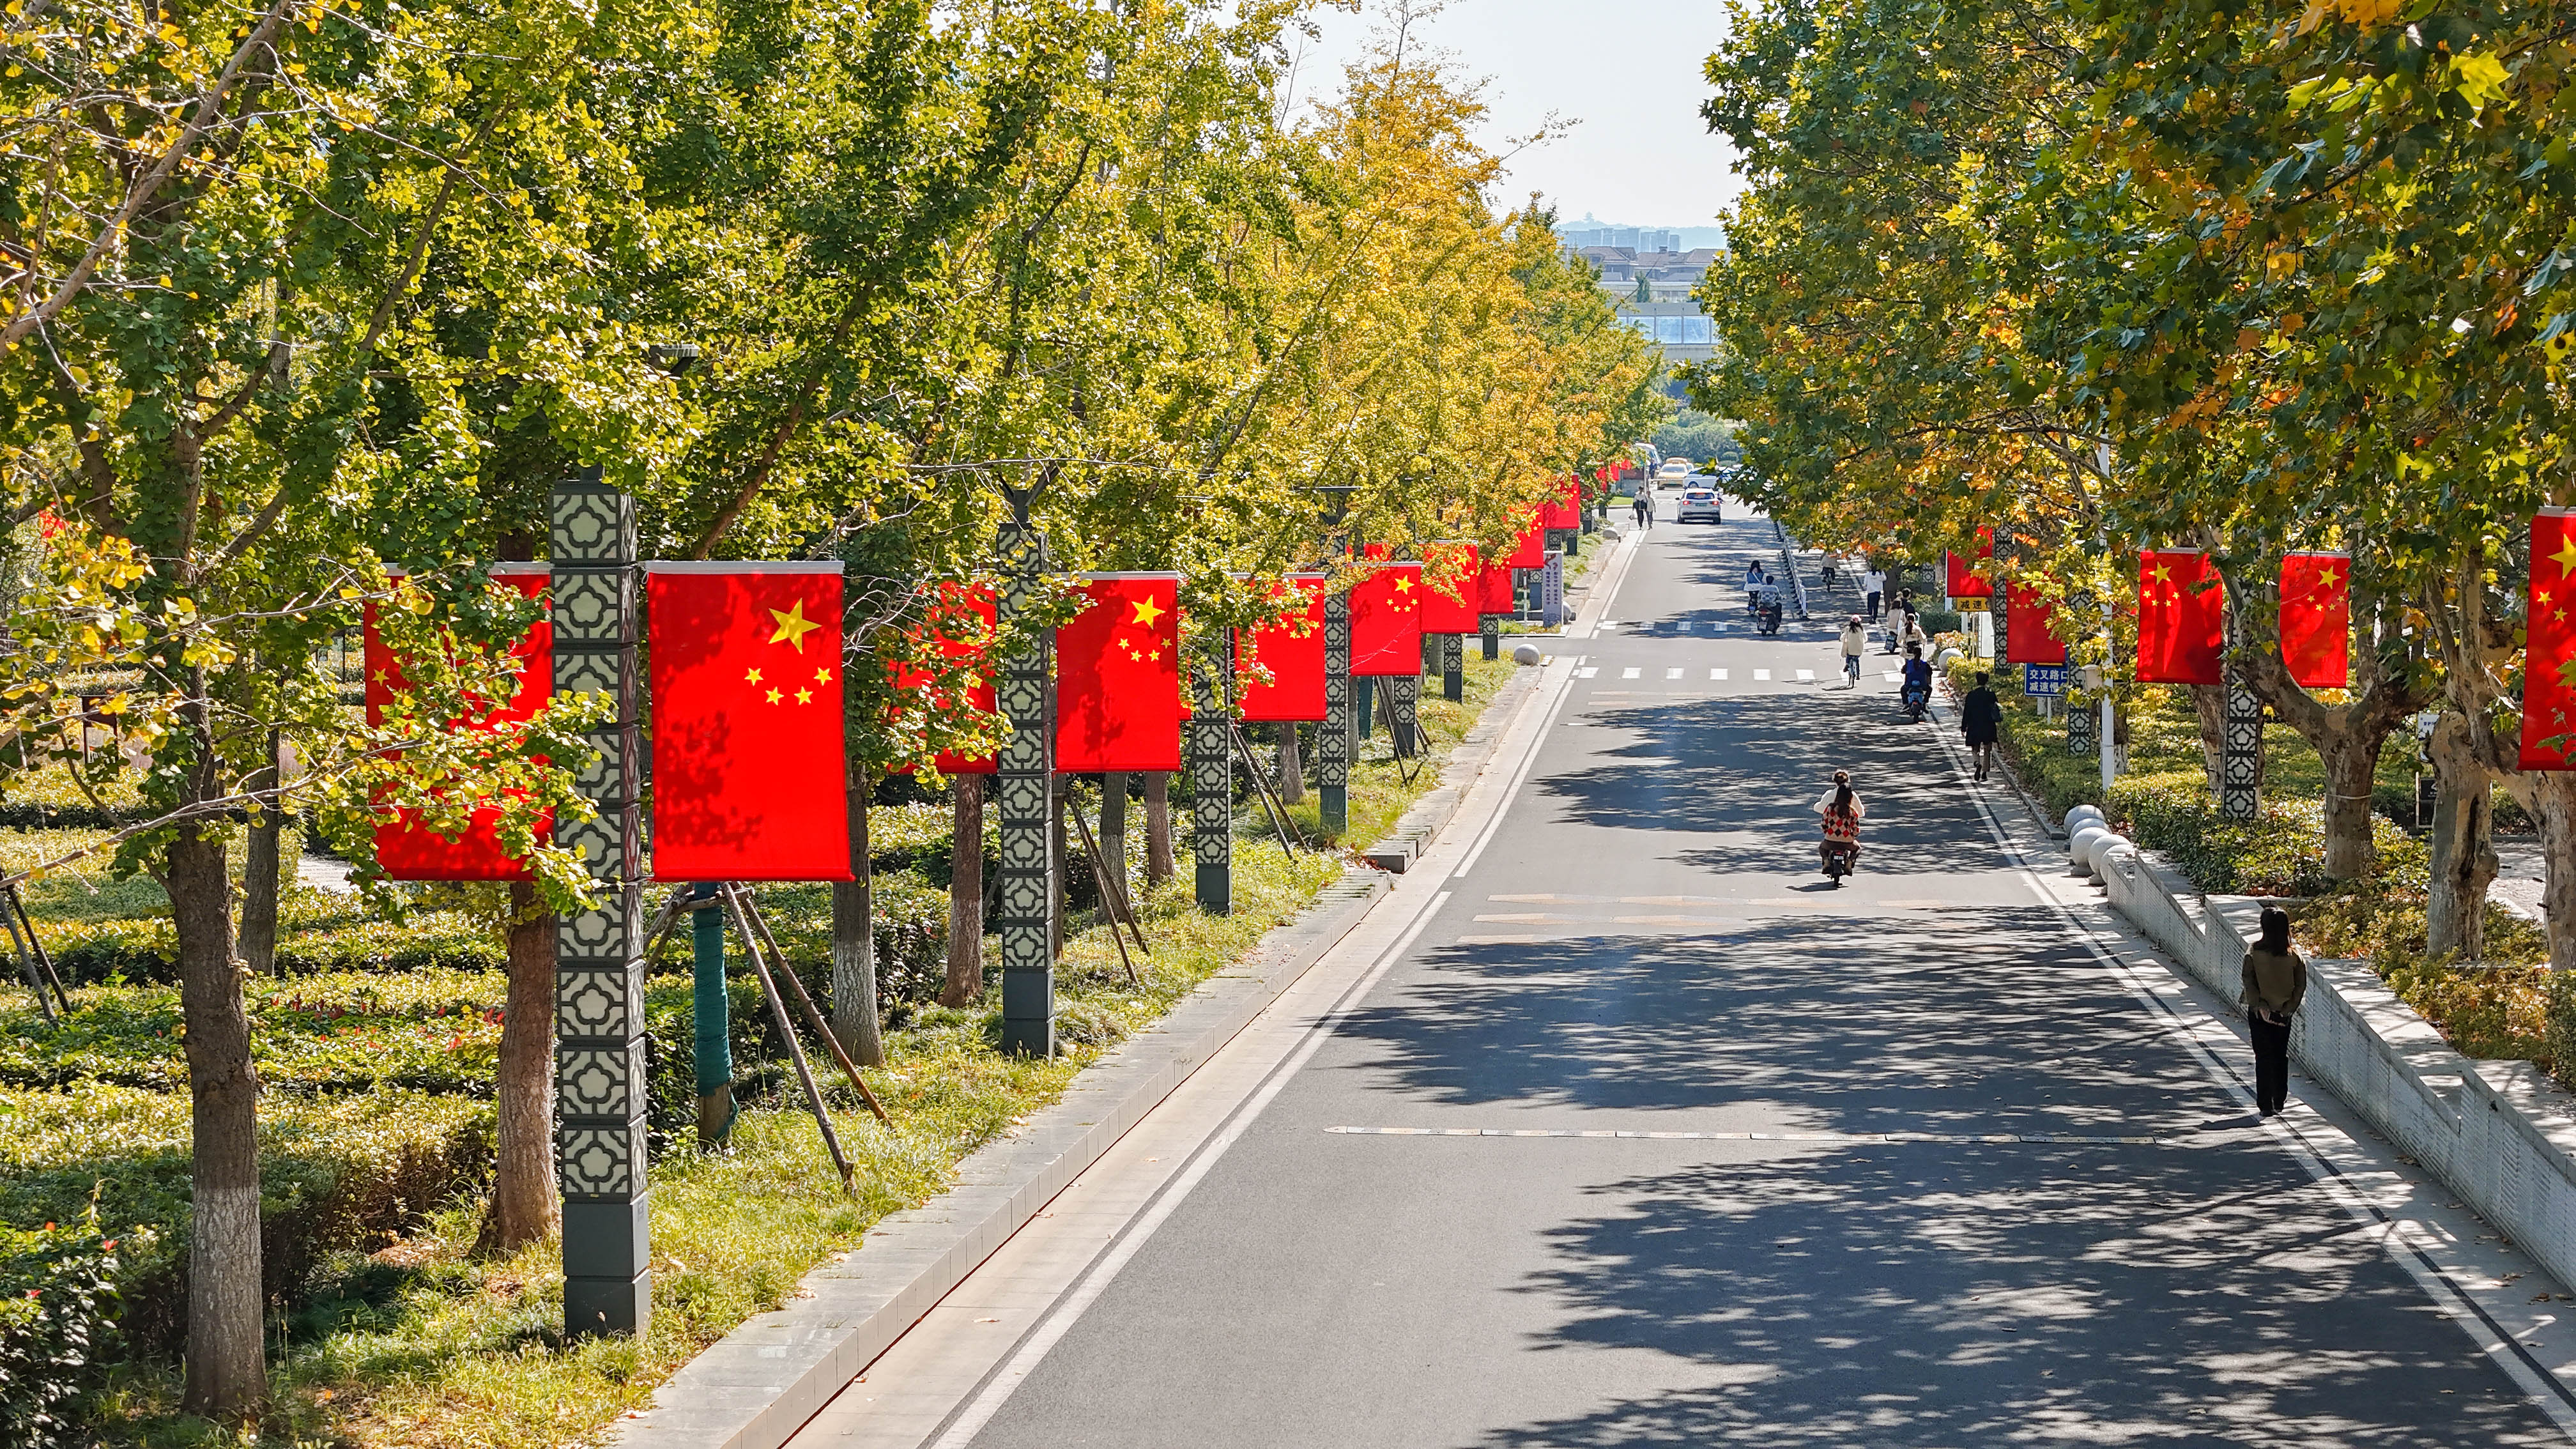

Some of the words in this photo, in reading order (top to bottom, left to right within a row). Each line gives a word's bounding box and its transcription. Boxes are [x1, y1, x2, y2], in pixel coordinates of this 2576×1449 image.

[1960, 600, 1988, 609] 减速
[2030, 670, 2069, 680] 交叉路口
